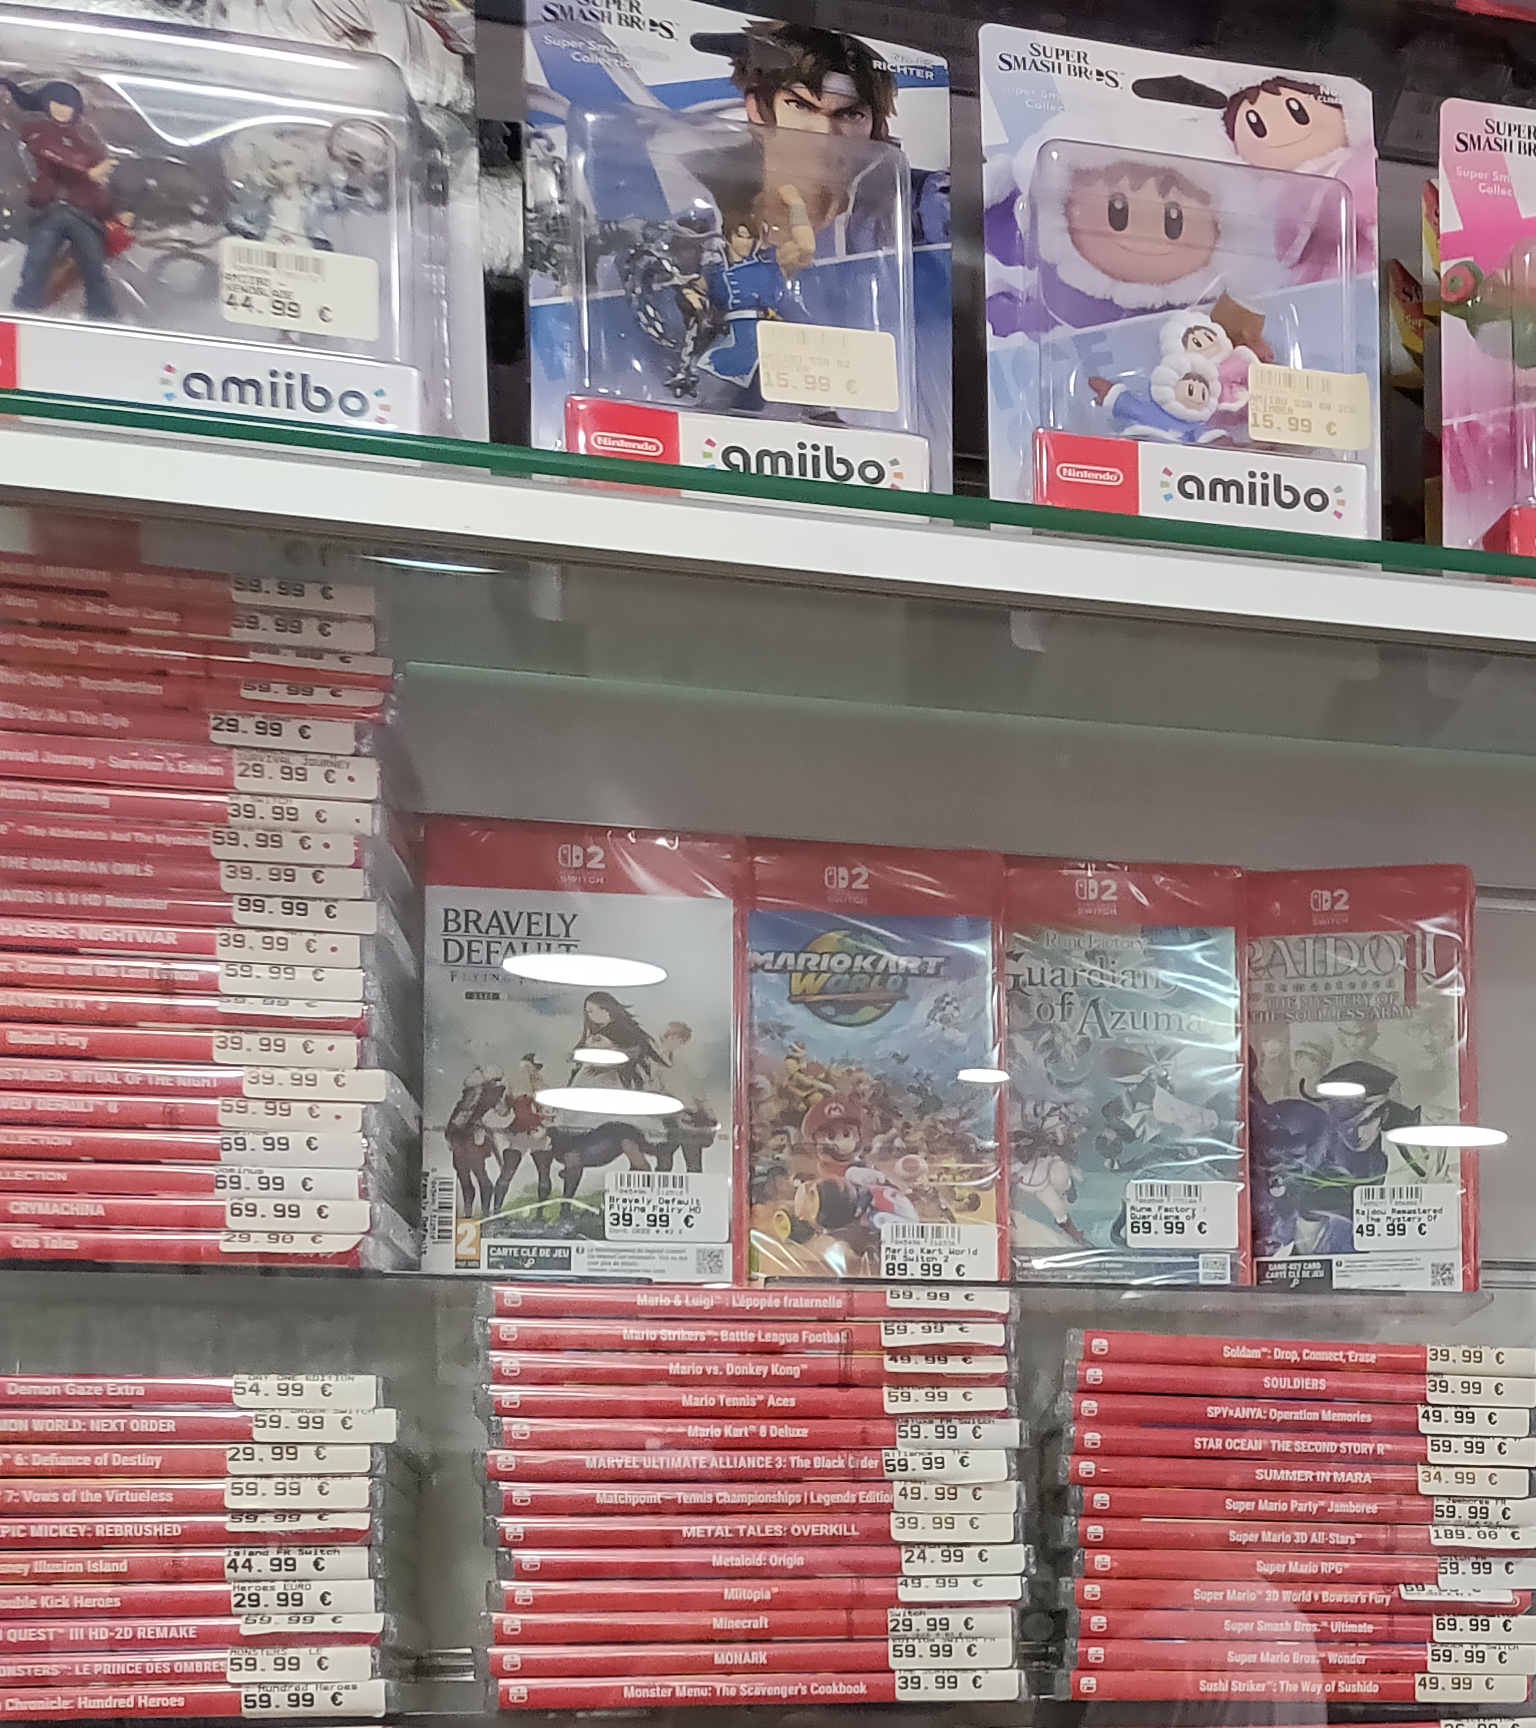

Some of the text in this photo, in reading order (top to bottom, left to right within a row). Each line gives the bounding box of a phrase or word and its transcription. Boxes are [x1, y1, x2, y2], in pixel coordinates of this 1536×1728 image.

[1029, 42, 1089, 66] SUPER
[873, 59, 935, 81] RICHTER
[998, 51, 1058, 78] SMASH
[224, 294, 332, 322] 44.99 €
[182, 368, 370, 418] amiibo
[1250, 412, 1338, 436] 15.99 €
[722, 442, 886, 485] amiibo
[1061, 466, 1120, 484] Nintendo
[1178, 473, 1329, 514] amiibo
[443, 909, 578, 938] BRAVELY
[10, 1201, 104, 1216] CRYMACHINA
[609, 1213, 694, 1229] 39.99 €
[490, 1246, 569, 1259] CARTE CLÉ DE JEU
[7, 1383, 144, 1397] Demon Gaze Extra
[234, 1383, 332, 1397] 54.99 €
[1264, 1377, 1327, 1390] SOULDIERS
[1256, 1469, 1372, 1483] SUMMER IN MARA
[683, 1523, 859, 1537] METAL TALES: OVERKILL
[713, 1617, 768, 1631] Minecraft
[715, 1652, 767, 1665] MONARK
